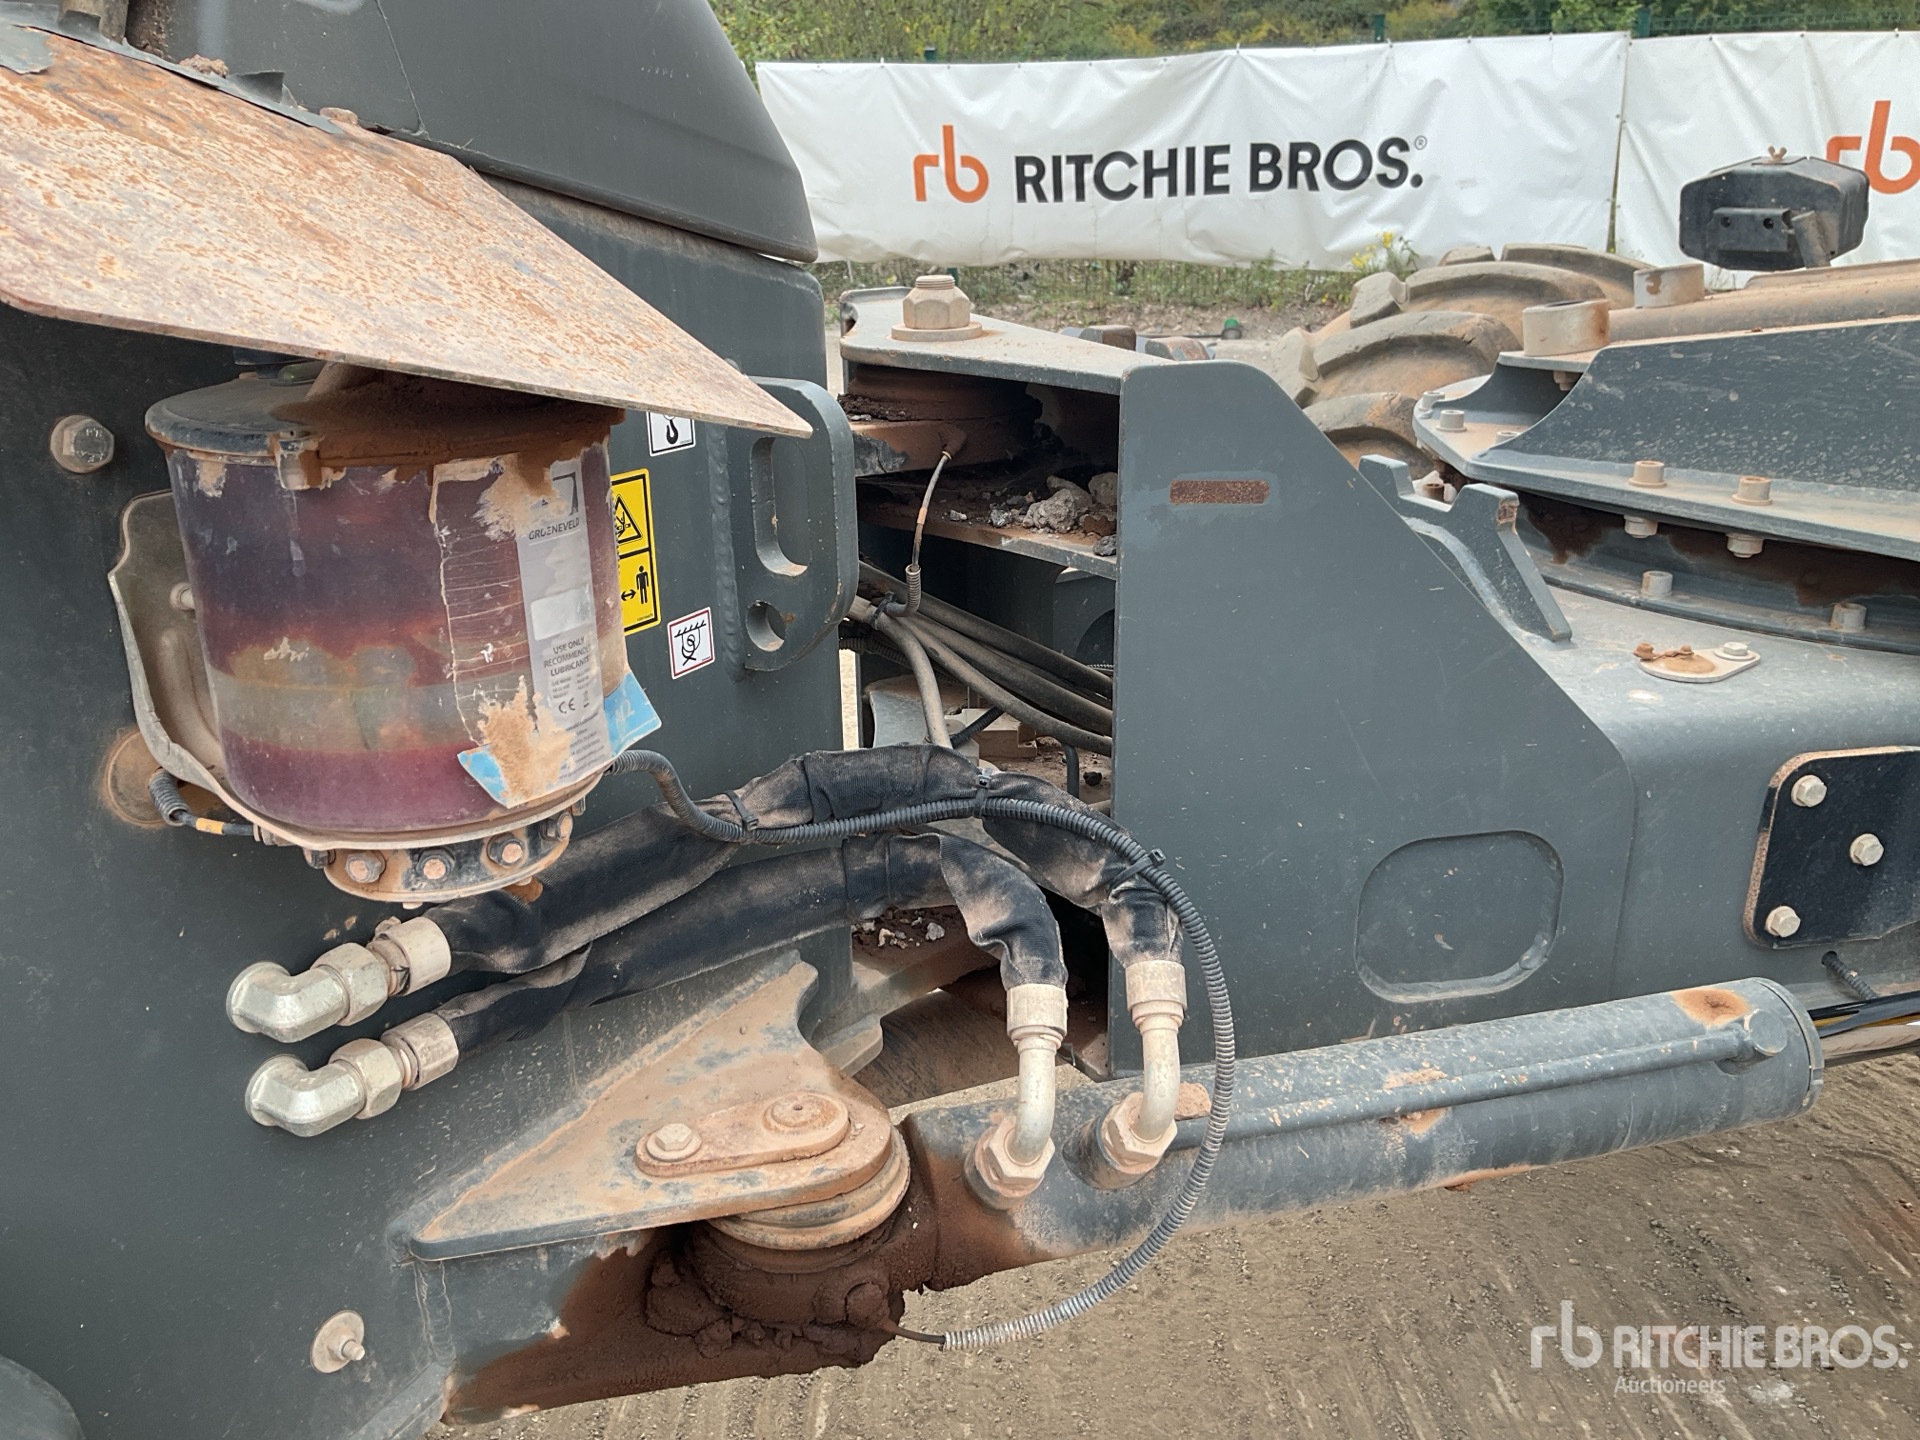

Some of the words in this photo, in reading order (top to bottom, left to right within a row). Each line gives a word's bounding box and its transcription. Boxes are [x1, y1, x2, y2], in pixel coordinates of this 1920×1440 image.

[913, 125, 989, 204] rb
[1015, 144, 1231, 203] RITCHIE
[529, 517, 580, 540] GROENEVELD
[553, 644, 567, 654] USE
[568, 636, 584, 649] ONLY
[550, 655, 590, 677] LUBRICANTS
